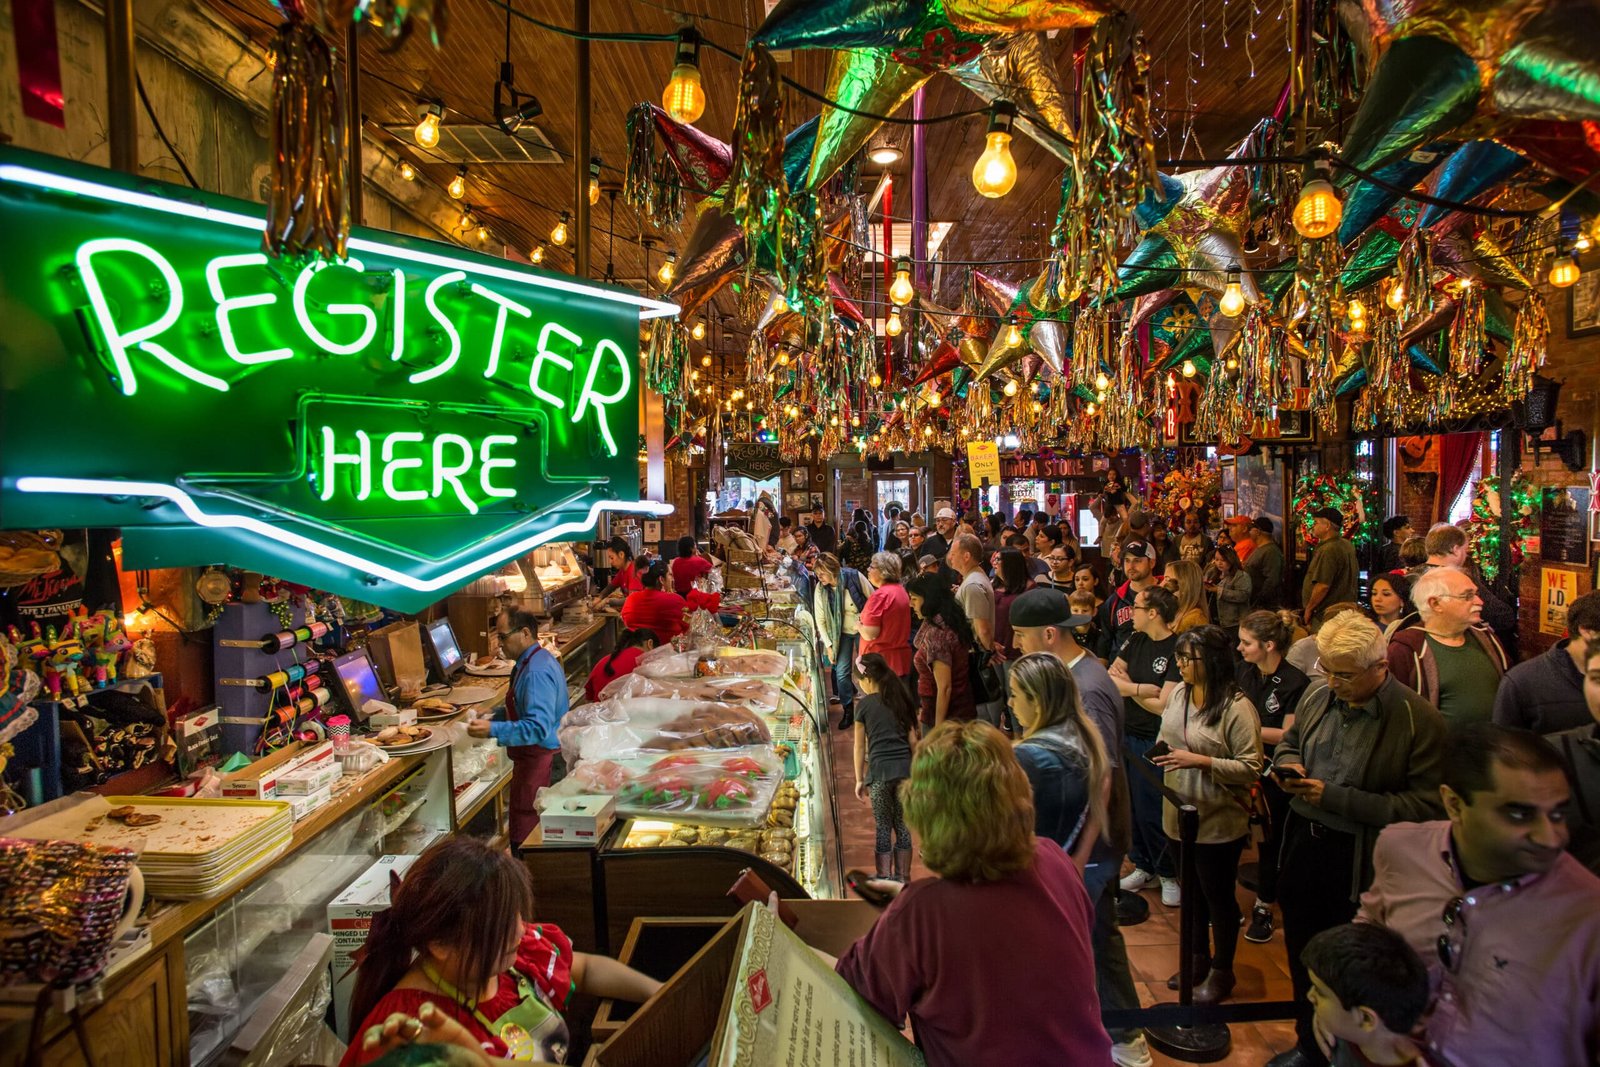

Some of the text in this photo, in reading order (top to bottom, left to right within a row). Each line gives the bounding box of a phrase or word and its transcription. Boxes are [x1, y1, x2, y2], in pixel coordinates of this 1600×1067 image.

[75, 237, 632, 457] REGISTER
[319, 424, 518, 514] HERE
[749, 461, 770, 471] HERE
[1044, 458, 1084, 476] STORE
[1547, 572, 1567, 590] WE
[1548, 588, 1569, 607] I.D.
[1116, 606, 1133, 626] HO
[354, 919, 372, 928] Clas
